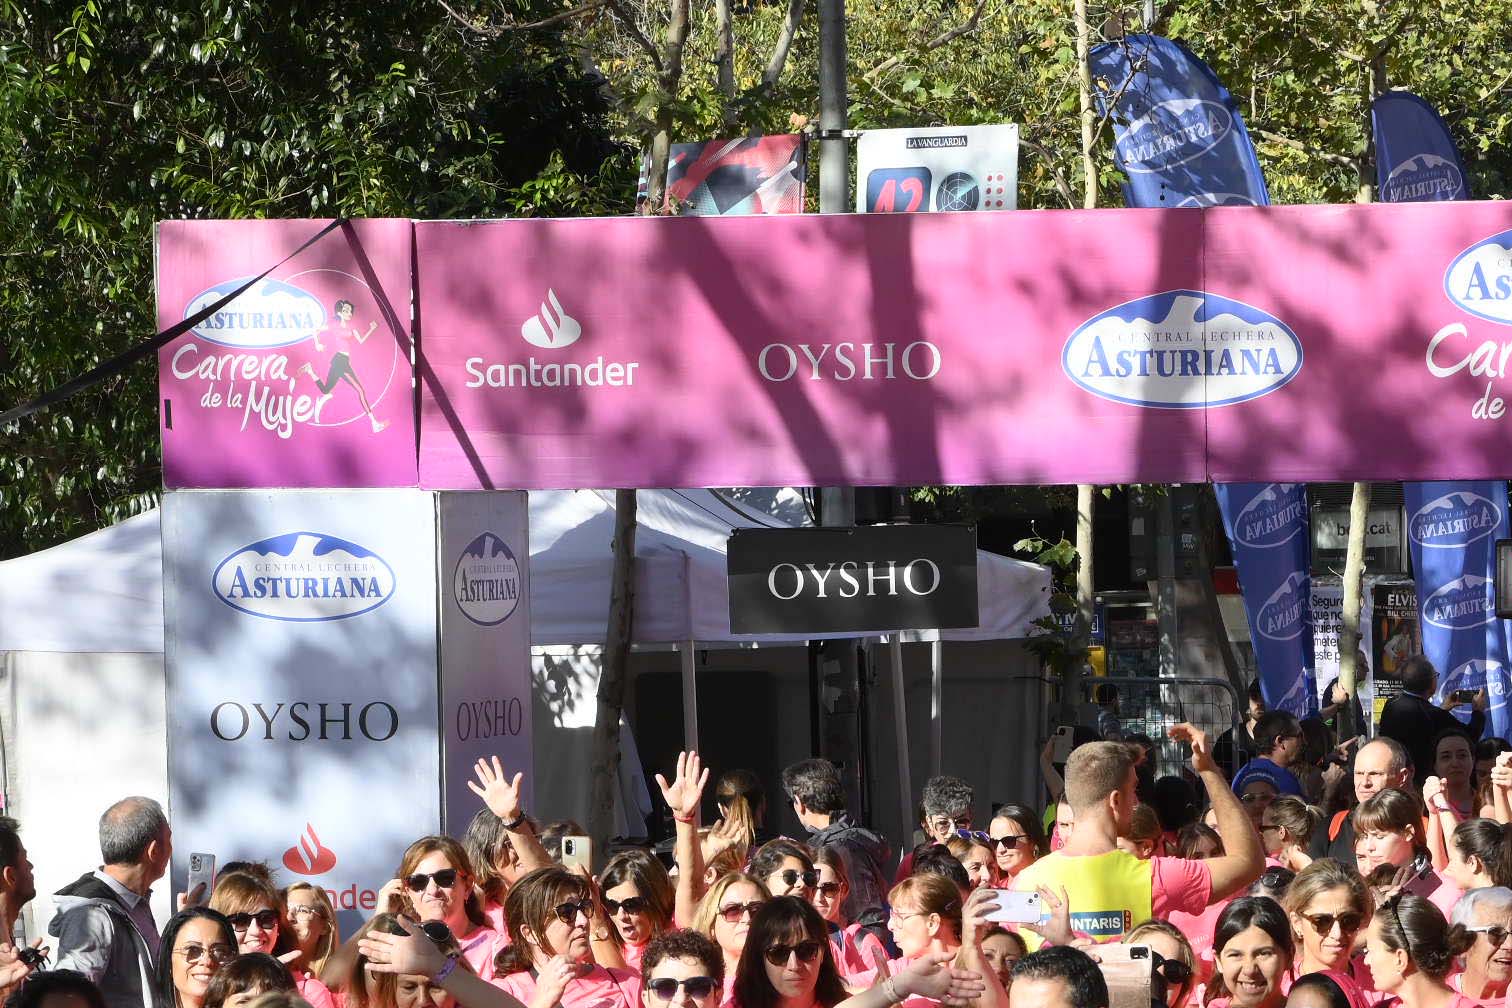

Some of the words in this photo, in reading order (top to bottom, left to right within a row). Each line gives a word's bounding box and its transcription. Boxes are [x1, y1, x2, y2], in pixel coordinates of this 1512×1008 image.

[196, 303, 318, 330] ASTURIANA
[171, 343, 289, 380] Carrera
[466, 357, 639, 389] Santander
[758, 340, 942, 382] OYSHO
[1083, 334, 1285, 378] ASTURIANA
[200, 383, 222, 408] de
[227, 381, 242, 408] la
[241, 377, 333, 439] Mujer
[1471, 384, 1505, 421] de
[227, 566, 382, 600] ASTURIANA
[254, 563, 313, 573] CENTRAL
[460, 568, 517, 602] ASTURIANA
[767, 558, 941, 600] OYSHO
[1387, 595, 1418, 606] ELVIS
[210, 701, 399, 743] OYSHO
[457, 697, 522, 742] OYSHO
